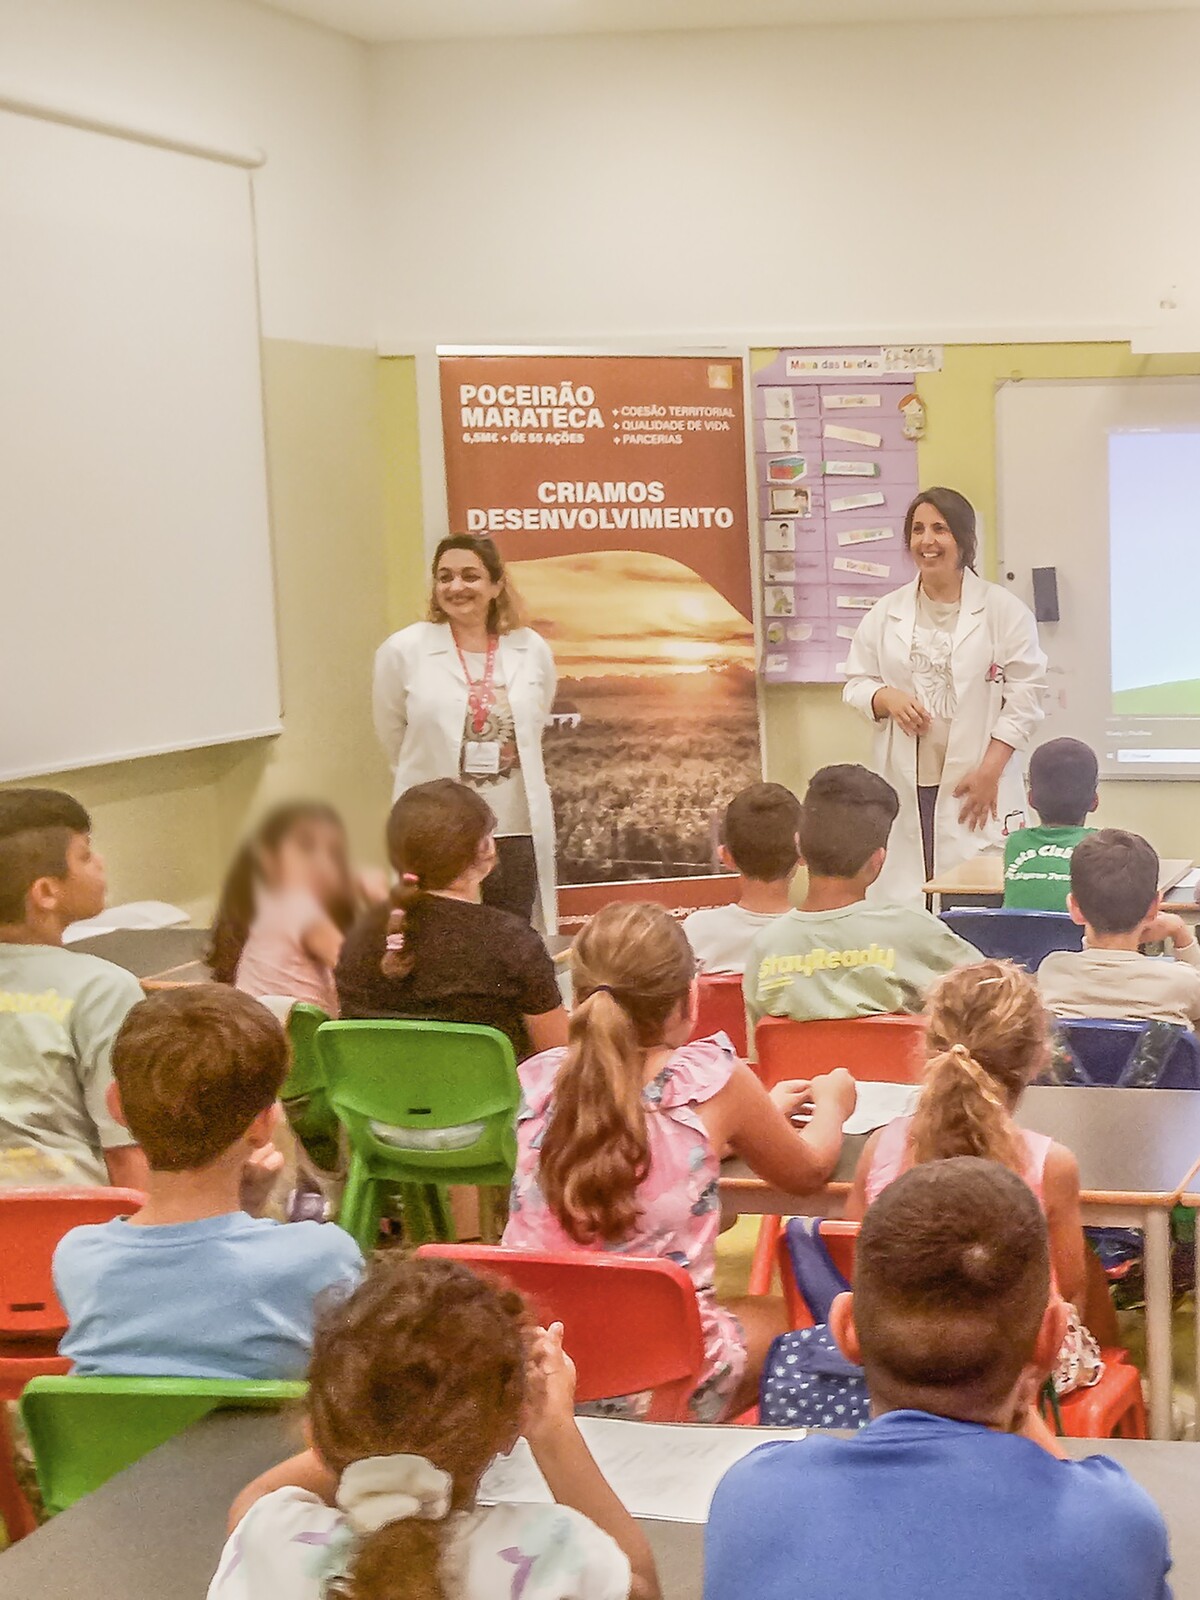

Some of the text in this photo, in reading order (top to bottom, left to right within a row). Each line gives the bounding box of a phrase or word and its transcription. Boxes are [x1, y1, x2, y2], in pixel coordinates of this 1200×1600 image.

[459, 380, 596, 407] POCEIRÃO
[460, 406, 606, 429] MARATECA
[620, 404, 667, 417] COESÃO
[668, 405, 736, 418] TERRITORIAL
[621, 420, 686, 431] QUALIDADE
[687, 420, 702, 431] DE
[704, 420, 731, 431] VIDA
[545, 430, 586, 446] AÇÕES
[622, 434, 683, 445] PARCERIAS
[537, 480, 666, 504] CRIAMOS
[466, 506, 735, 531] DESENVOLVIMENTO
